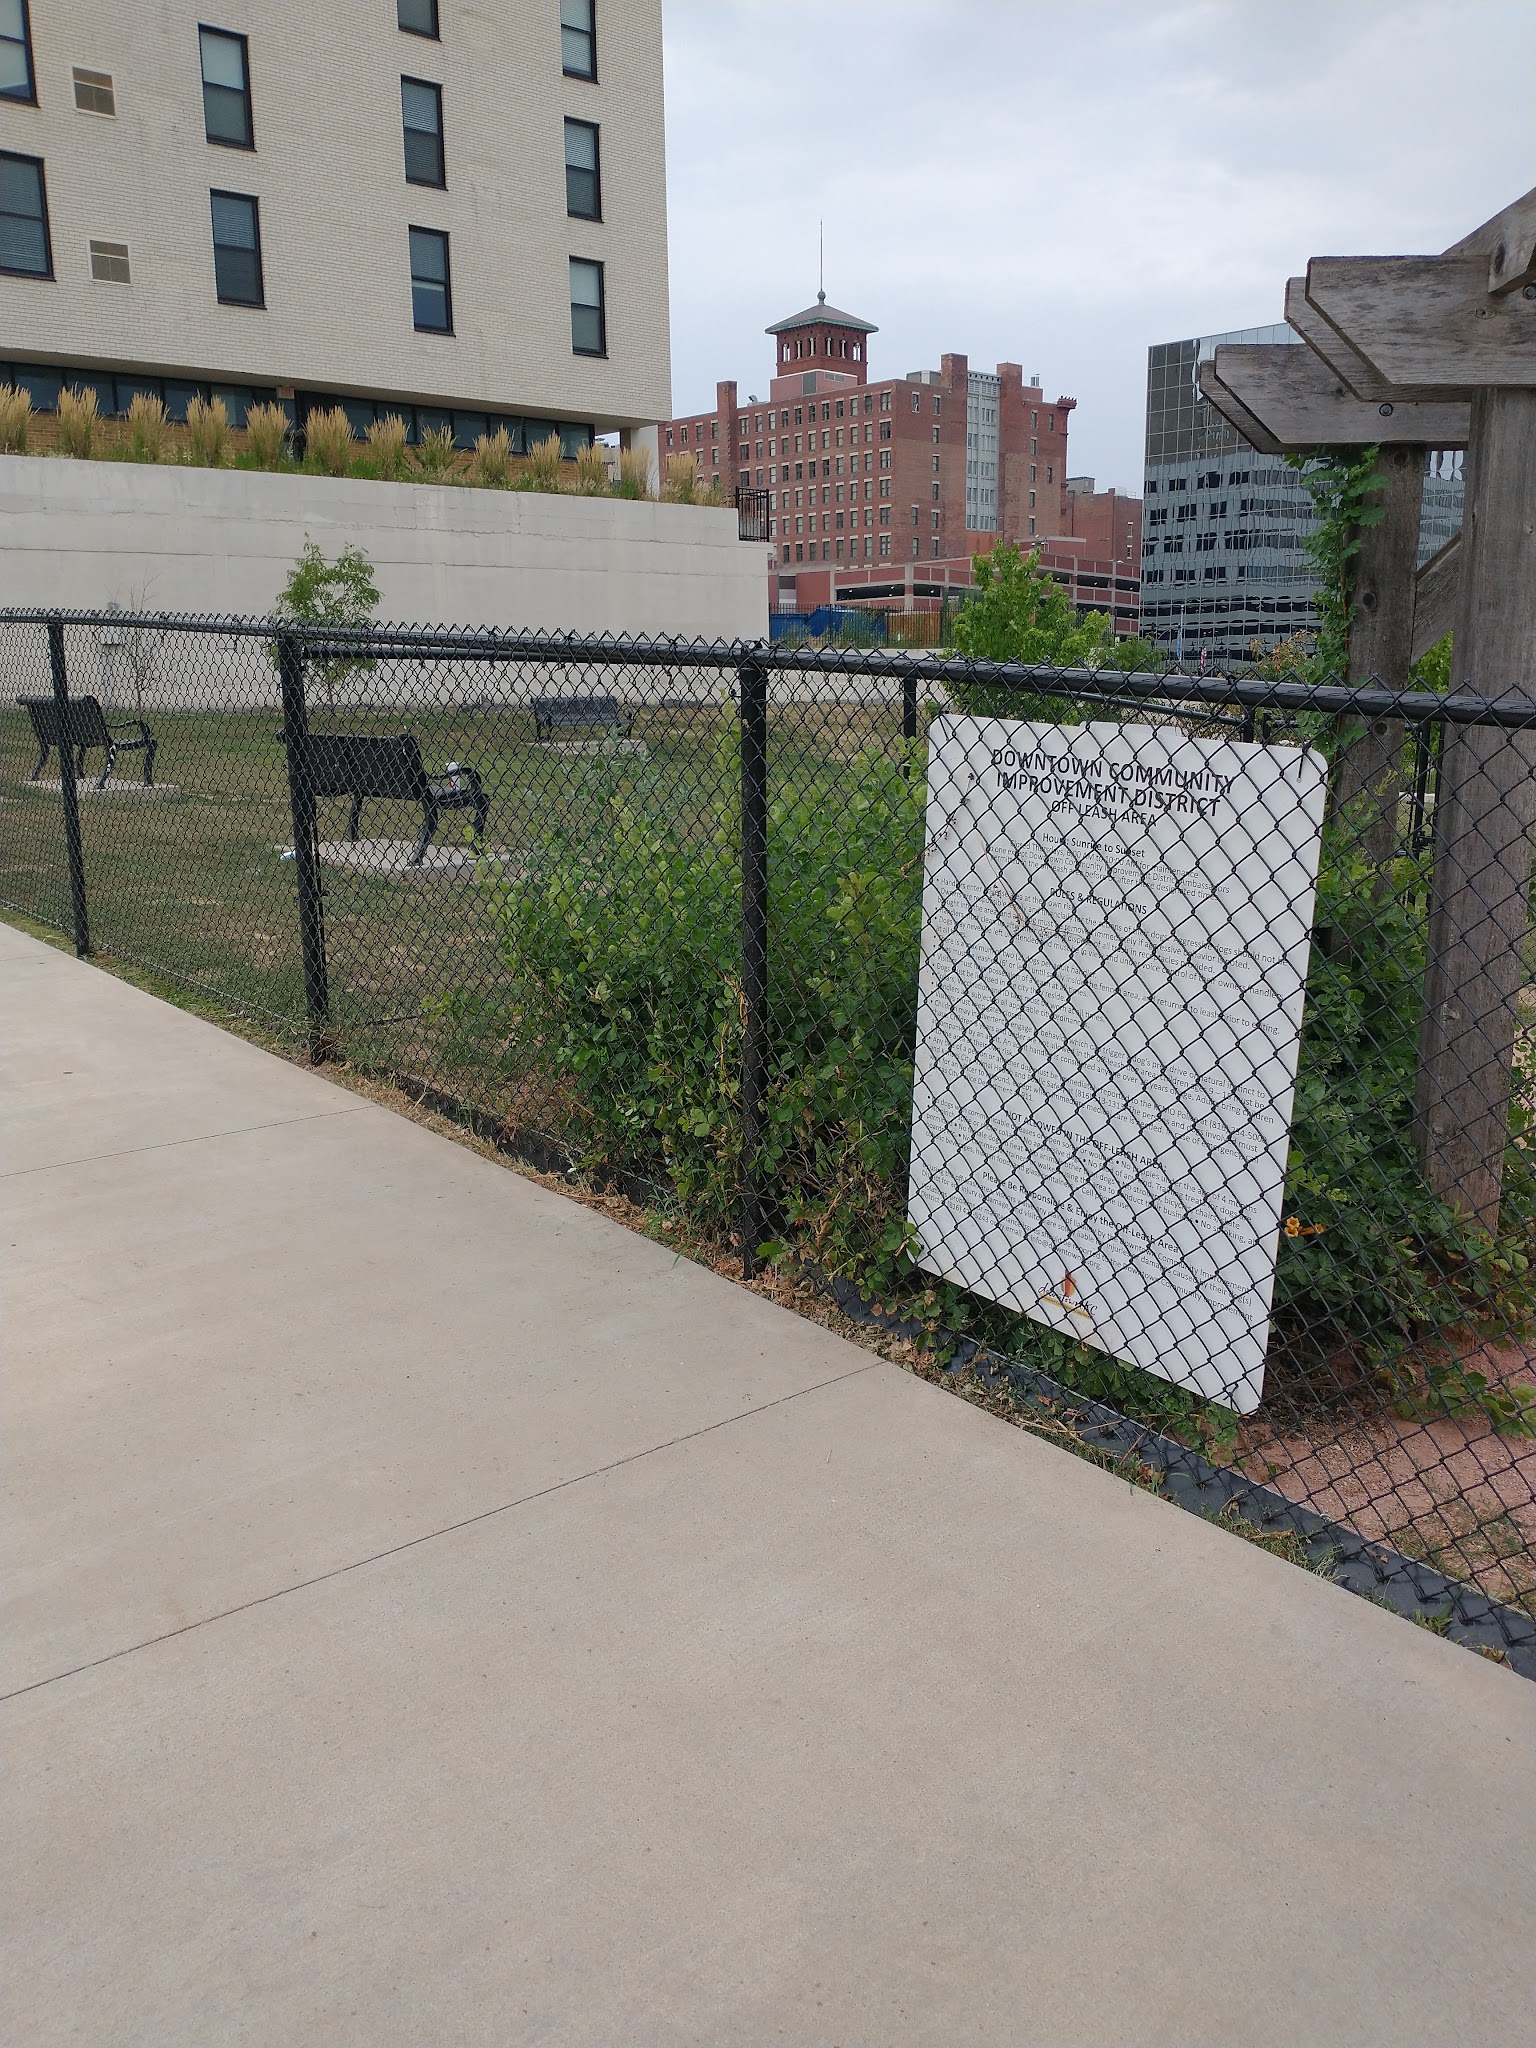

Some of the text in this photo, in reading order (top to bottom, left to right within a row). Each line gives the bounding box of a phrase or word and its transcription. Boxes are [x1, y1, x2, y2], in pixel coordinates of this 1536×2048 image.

[992, 748, 1234, 794] DOWNTOWN COMMUNITY
[997, 771, 1220, 817] IMPROVEMENT DISTRICT
[1051, 799, 1157, 827] OFF LEASH AREA
[1042, 832, 1145, 858] Hou: Sunrie to Suset
[1118, 876, 1133, 885] after
[1152, 873, 1177, 884] Distric
[1178, 877, 1229, 893] Ambassaors
[1050, 886, 1147, 914] RULES & REGULATIONS
[1037, 919, 1053, 927] must
[1002, 951, 1014, 959] two
[1085, 918, 1096, 926] the
[1261, 955, 1275, 963] not
[936, 963, 950, 973] Dogs
[1044, 992, 1065, 1002] reside.
[1031, 968, 1045, 976] until
[1122, 990, 1140, 1001] area,
[1156, 998, 1188, 1011] returne
[1190, 1006, 1198, 1014] to
[1220, 1014, 1239, 1024] rior
[1241, 1018, 1248, 1026] to
[1251, 1022, 1279, 1035] eiting.
[1103, 1047, 1125, 1059] trigger
[1151, 1062, 1167, 1073] pre
[1169, 1065, 1187, 1077] drive
[1226, 1082, 1255, 1096] intinct
[1257, 1091, 1265, 1099] to
[1122, 1074, 1137, 1084] over
[1149, 1082, 1168, 1092] years
[1221, 1102, 1240, 1115] bring
[1242, 1109, 1273, 1123] cldren
[1140, 1099, 1150, 1108] the
[1254, 1100, 1264, 1110] be
[1005, 1109, 1021, 1122] NOT
[1074, 1133, 1091, 1146] THE
[1170, 1120, 1184, 1129] and
[1238, 1141, 1257, 1152] must
[1087, 1159, 1097, 1168] No
[1121, 1160, 1130, 1170] No
[1183, 1182, 1195, 1192] the
[1212, 1193, 1220, 1201] of
[1007, 1180, 1017, 1191] Be
[1019, 1185, 1064, 1209] Rponsible
[1066, 1203, 1073, 1213] &
[1075, 1206, 1097, 1224] Enjoy
[1099, 1216, 1113, 1228] the
[1115, 1221, 1156, 1245] Off-Leash
[1157, 1237, 1178, 1253] Area
[1108, 1187, 1115, 1195] to
[1116, 1191, 1143, 1205] onduct
[1200, 1219, 1211, 1230] No
[1212, 1226, 1245, 1244] soking,
